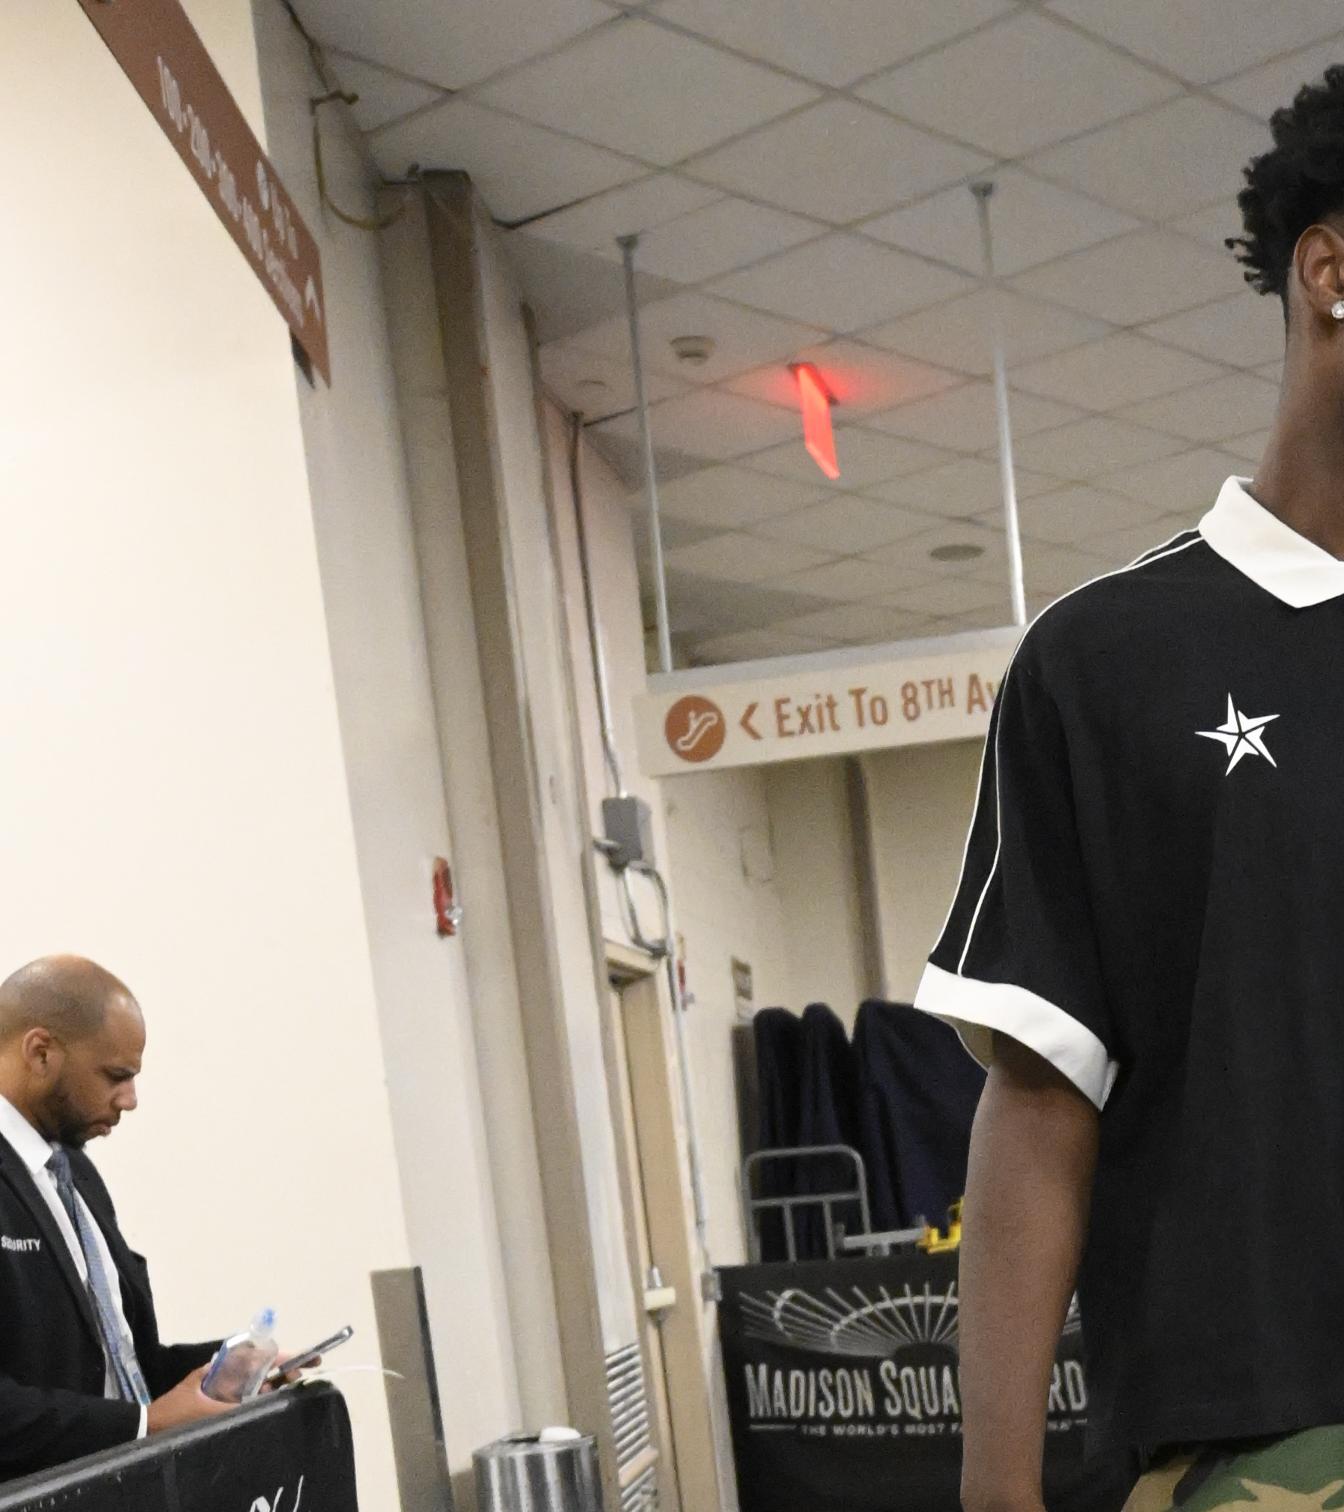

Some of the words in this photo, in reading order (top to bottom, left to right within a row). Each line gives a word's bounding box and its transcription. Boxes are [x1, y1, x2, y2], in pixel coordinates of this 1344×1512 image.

[775, 692, 841, 739] Exit
[848, 686, 889, 729] To
[900, 676, 955, 724] 8TH
[966, 672, 999, 715] Av
[745, 1362, 876, 1419] MADISON
[879, 1359, 961, 1420] SQUA
